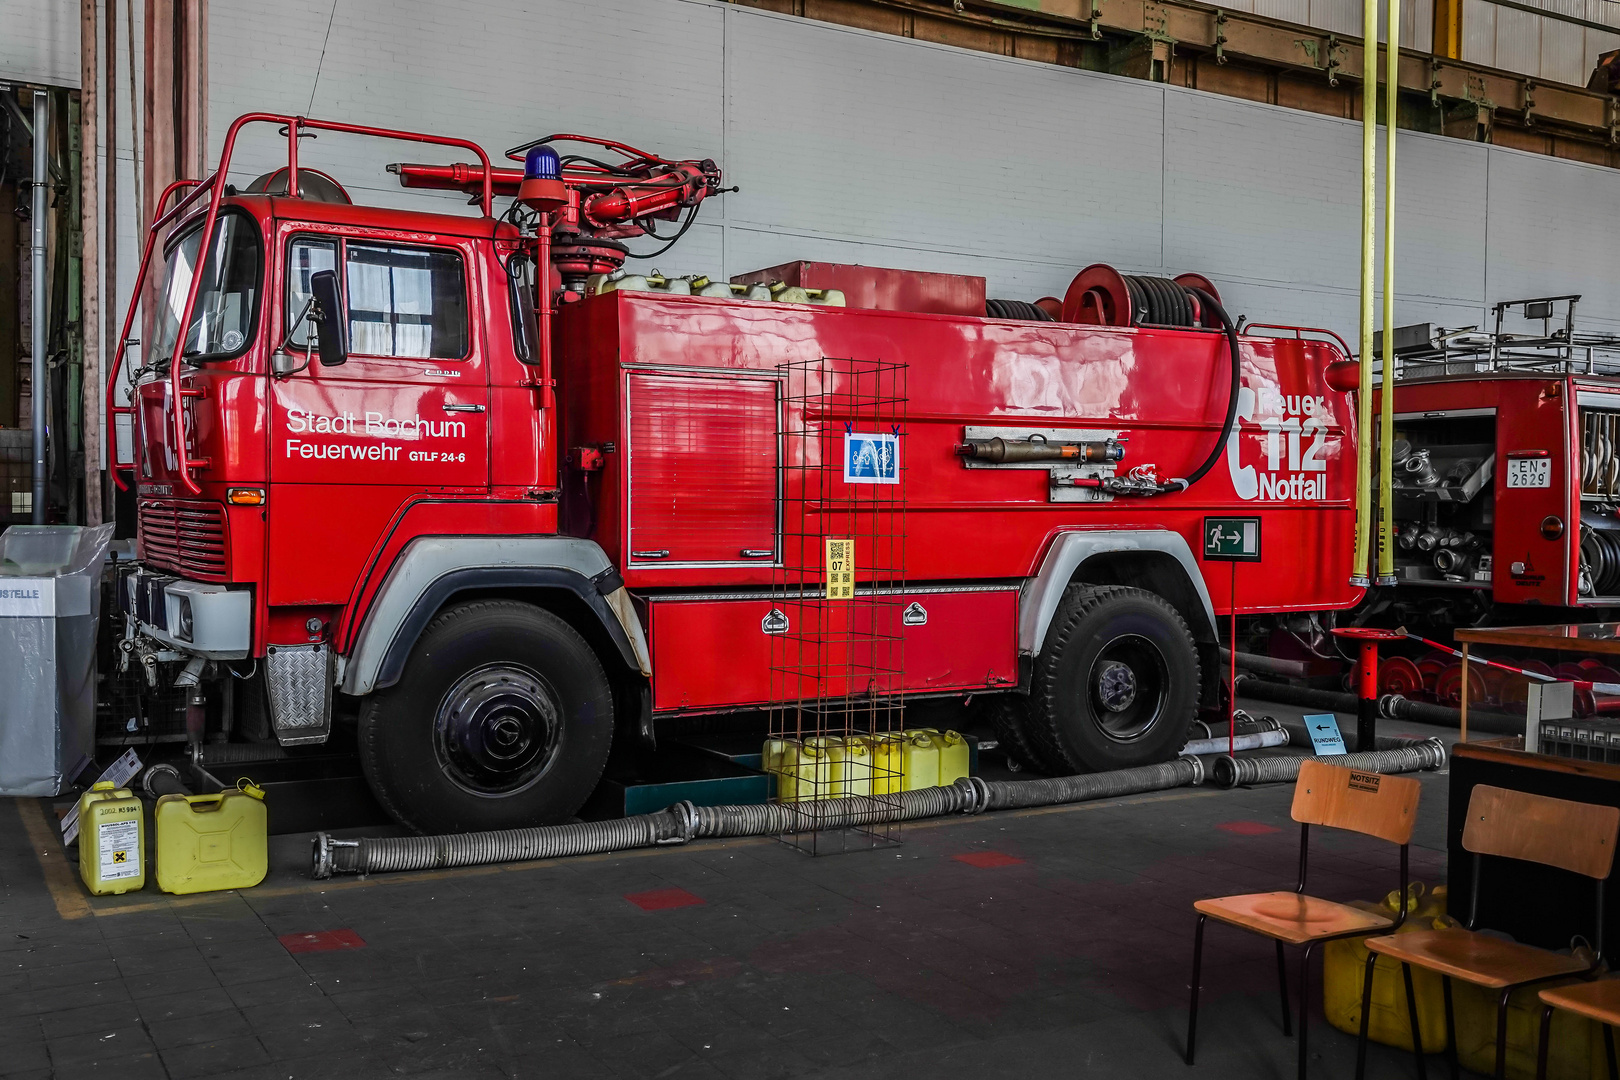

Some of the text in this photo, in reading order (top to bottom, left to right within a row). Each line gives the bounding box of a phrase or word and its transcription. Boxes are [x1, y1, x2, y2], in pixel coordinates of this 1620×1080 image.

[1257, 387, 1325, 416] Feuer
[286, 408, 466, 438] Stadt Bochum
[286, 439, 402, 461] Feuerwehr
[408, 451, 438, 462] GTLF
[1259, 416, 1329, 471] 112
[1519, 460, 1538, 473] EN
[1259, 472, 1327, 500] Notfall
[1511, 473, 1545, 486] 2629
[832, 561, 843, 571] 07
[1350, 773, 1380, 785] NOTSITZ
